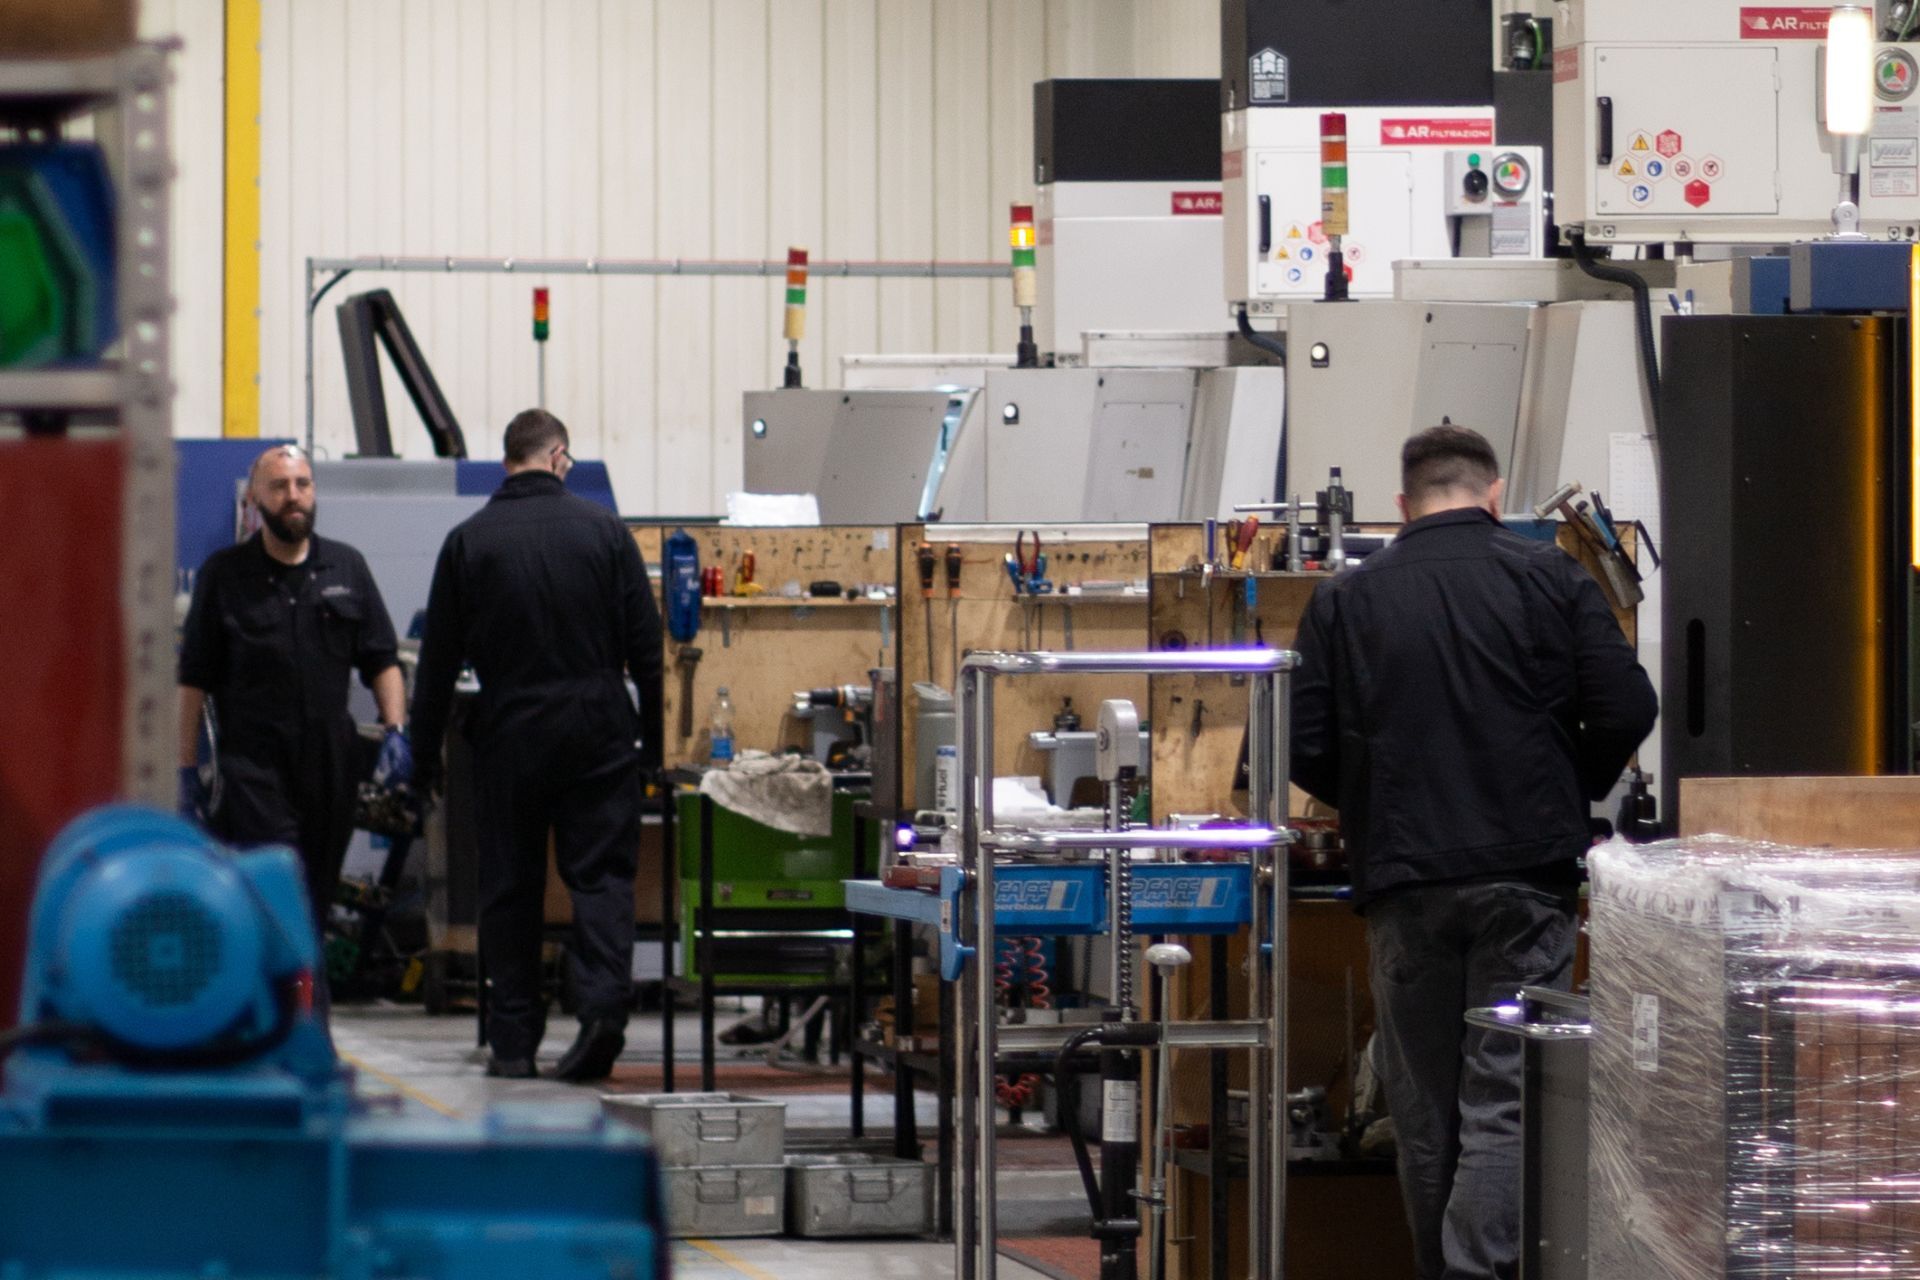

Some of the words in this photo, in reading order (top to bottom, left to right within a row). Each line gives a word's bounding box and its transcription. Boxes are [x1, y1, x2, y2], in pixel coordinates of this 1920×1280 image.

[1771, 16, 1799, 31] AR
[1407, 126, 1430, 138] AR
[1194, 197, 1216, 209] AR
[993, 880, 1051, 902] FAFF
